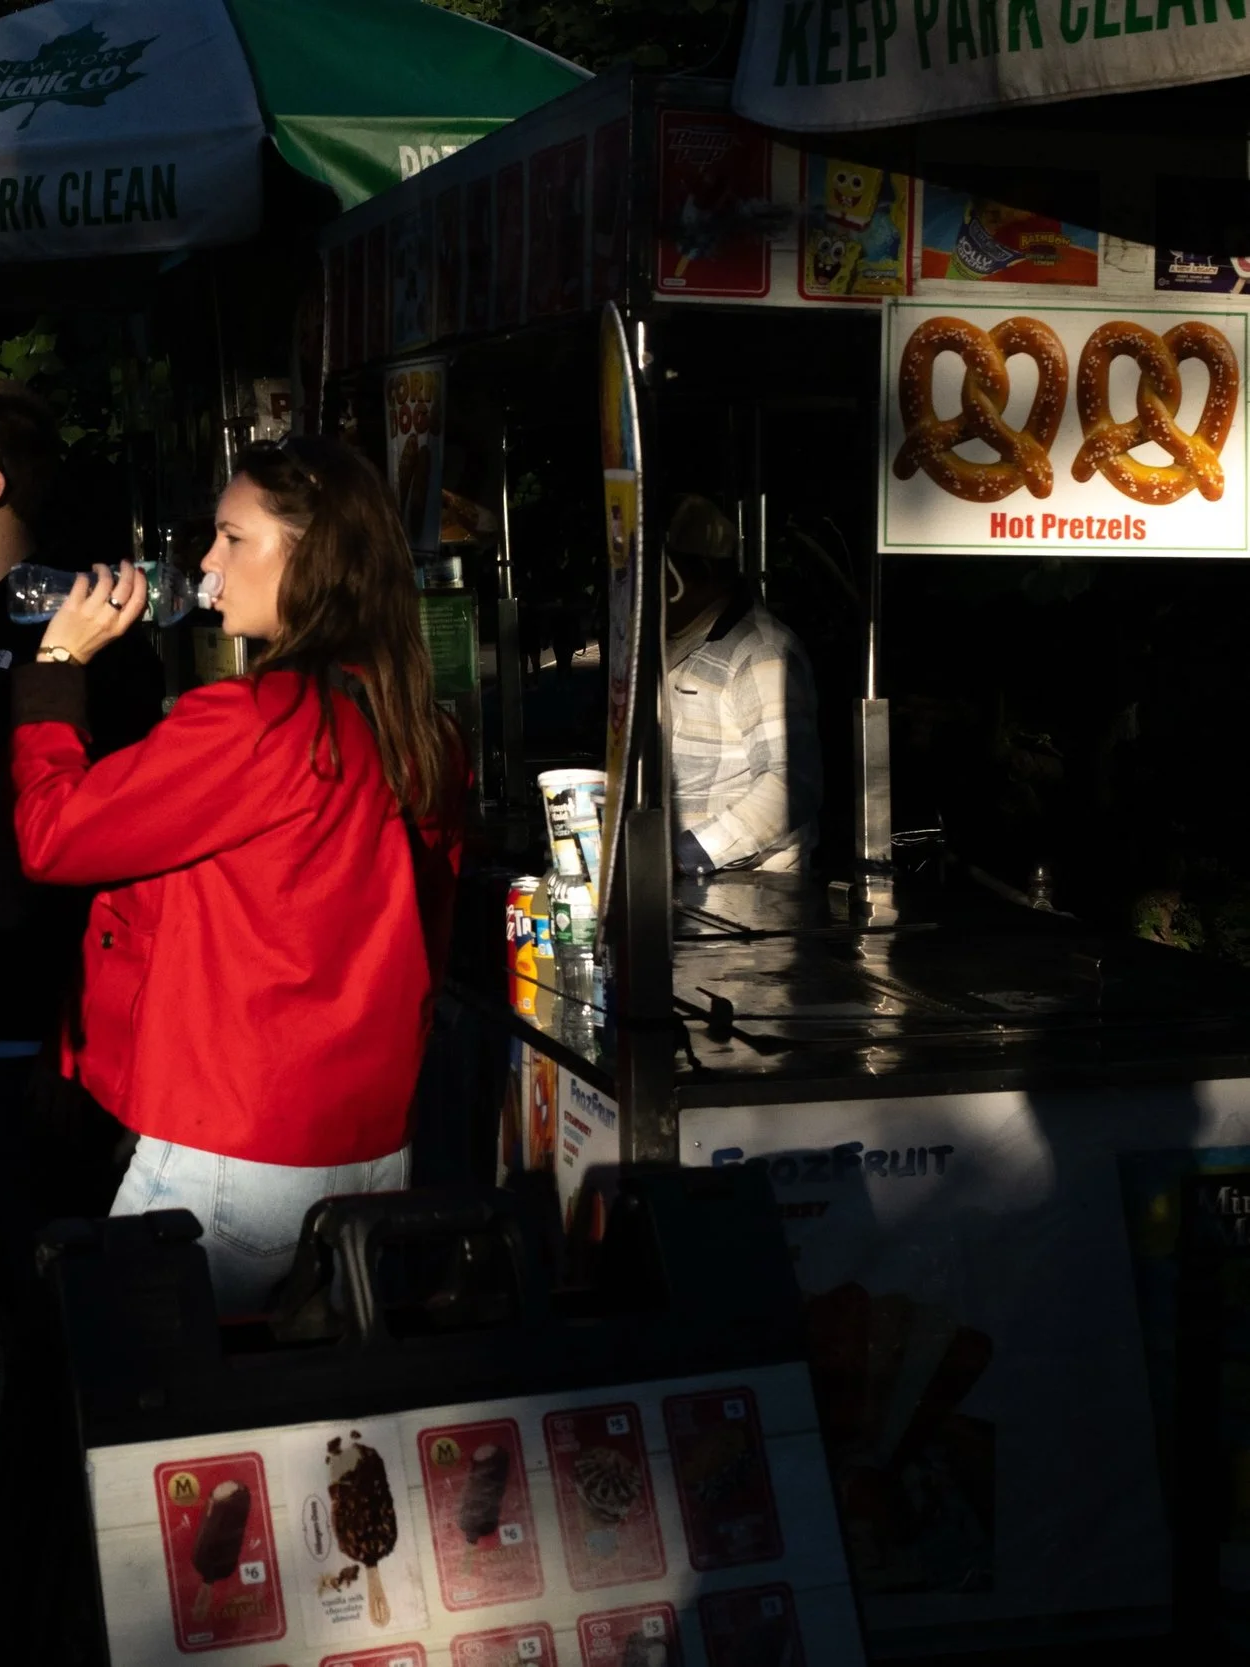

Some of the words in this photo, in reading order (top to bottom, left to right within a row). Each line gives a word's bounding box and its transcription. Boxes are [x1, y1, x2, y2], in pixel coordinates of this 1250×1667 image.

[773, 0, 898, 86] KEEP
[66, 50, 129, 68] YORK
[79, 65, 122, 89] CO
[58, 163, 178, 227] CLEAN
[959, 235, 993, 265] JOLLY
[1021, 232, 1070, 247] RAINBOW
[990, 512, 1035, 539] Hot
[1041, 513, 1146, 540] Pretzels
[245, 1567, 260, 1580] $6
[523, 1642, 535, 1653] $5
